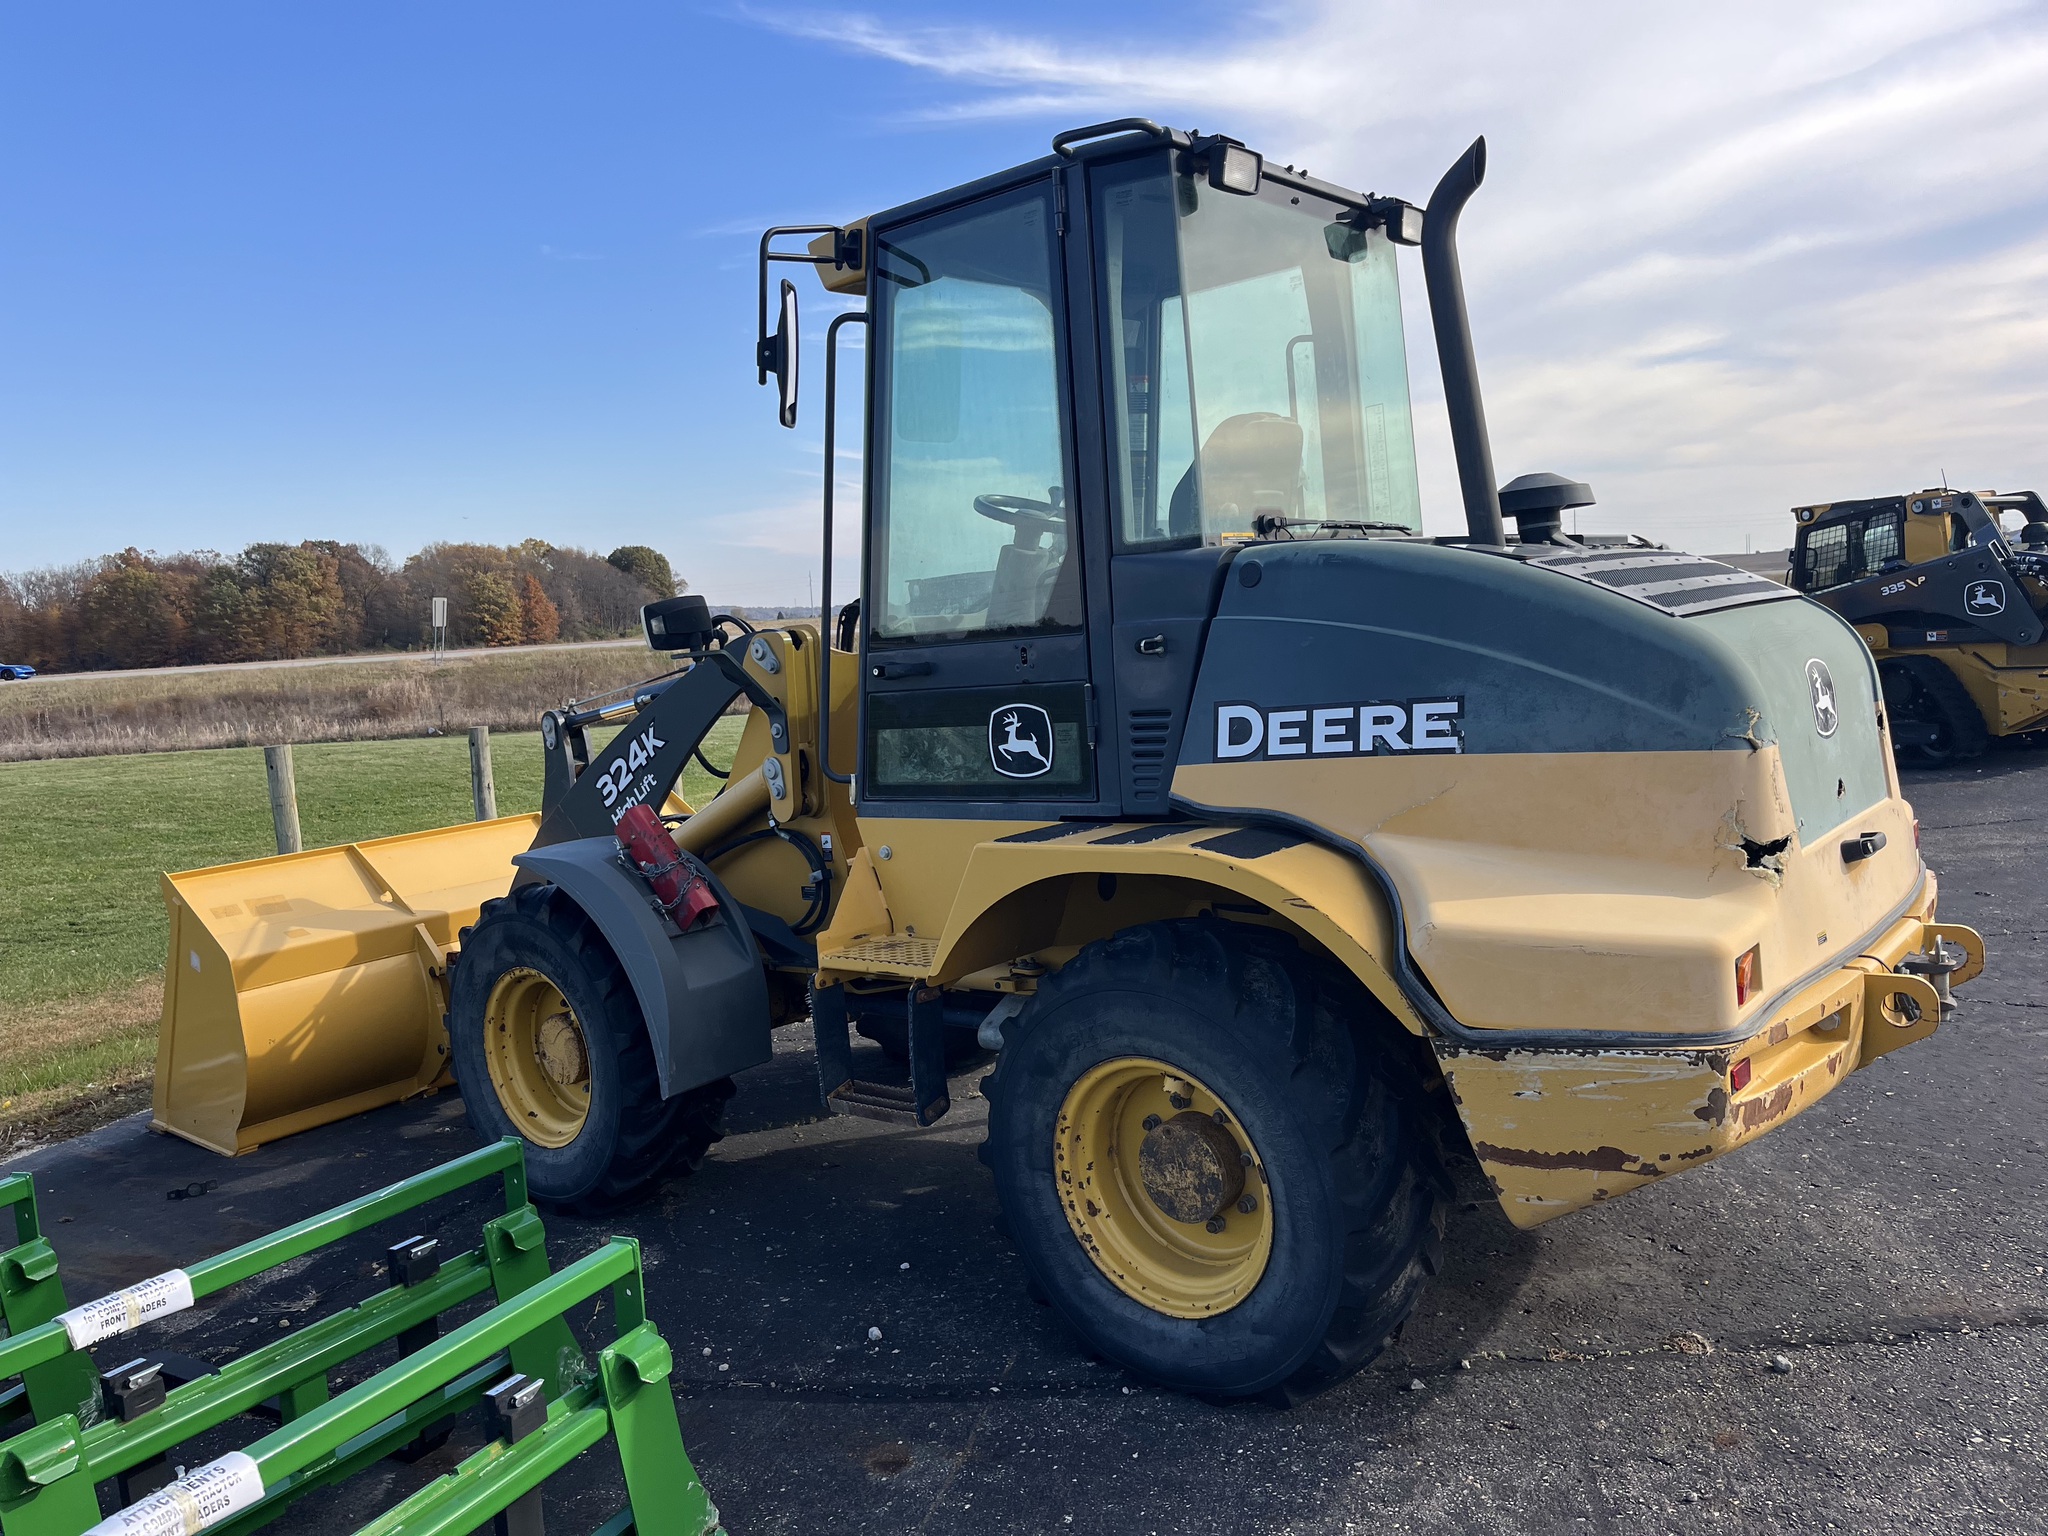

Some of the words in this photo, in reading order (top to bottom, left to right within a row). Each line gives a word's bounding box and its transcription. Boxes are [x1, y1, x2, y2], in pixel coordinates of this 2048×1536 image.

[1881, 581, 1906, 596] 335
[1217, 702, 1459, 758] DEERE
[596, 722, 665, 807] 324K
[634, 774, 657, 802] Lift
[100, 1311, 127, 1330] FRONT
